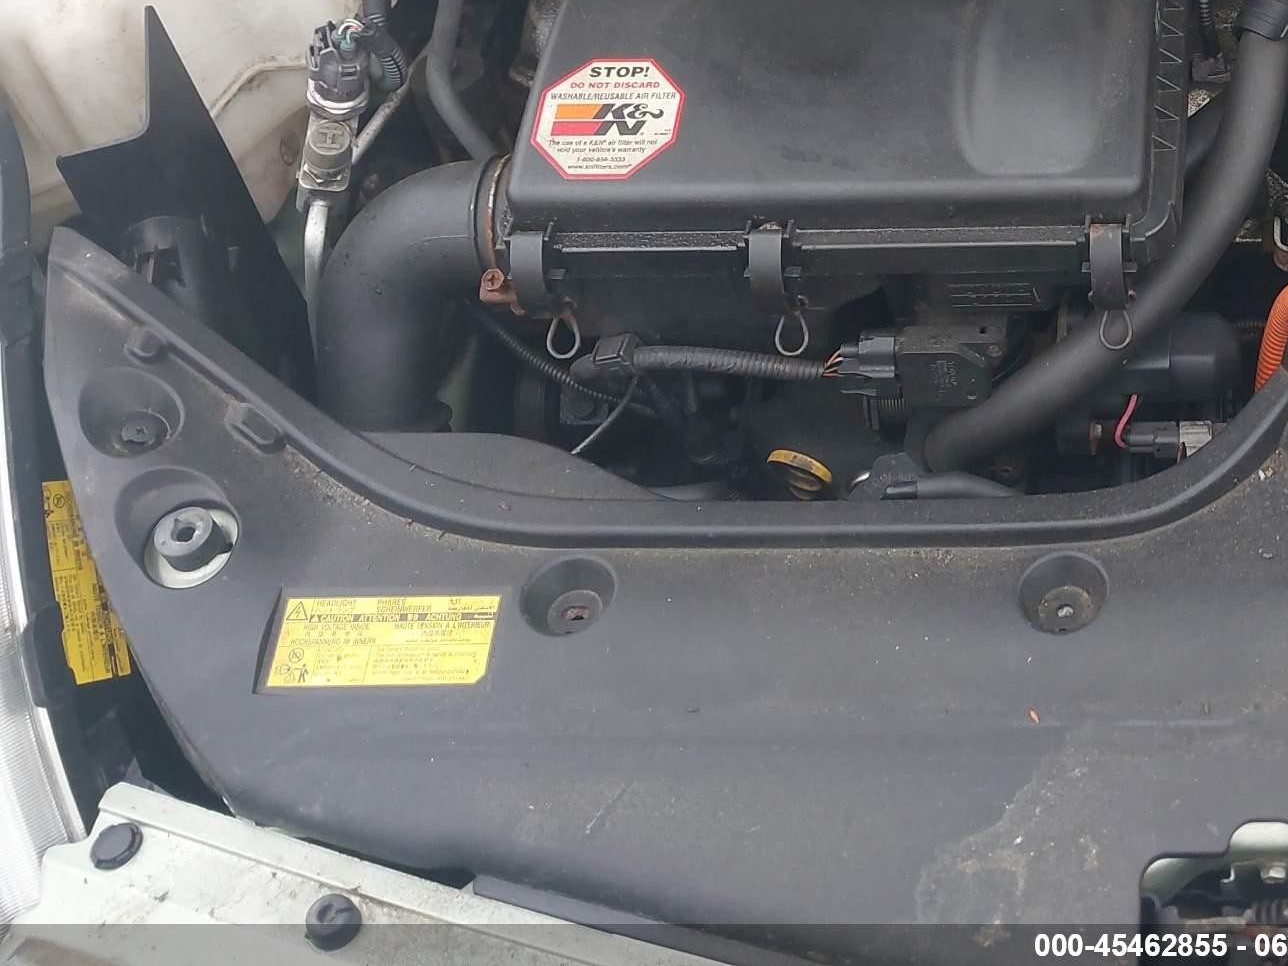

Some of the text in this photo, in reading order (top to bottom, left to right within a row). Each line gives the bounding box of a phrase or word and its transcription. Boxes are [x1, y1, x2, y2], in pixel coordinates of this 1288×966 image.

[589, 66, 650, 78] STOP!
[614, 81, 661, 89] DISCARD
[636, 92, 649, 100] AIR
[650, 92, 676, 100] FILTER
[321, 614, 353, 623] CAUTION
[359, 613, 400, 622] ATTENTION
